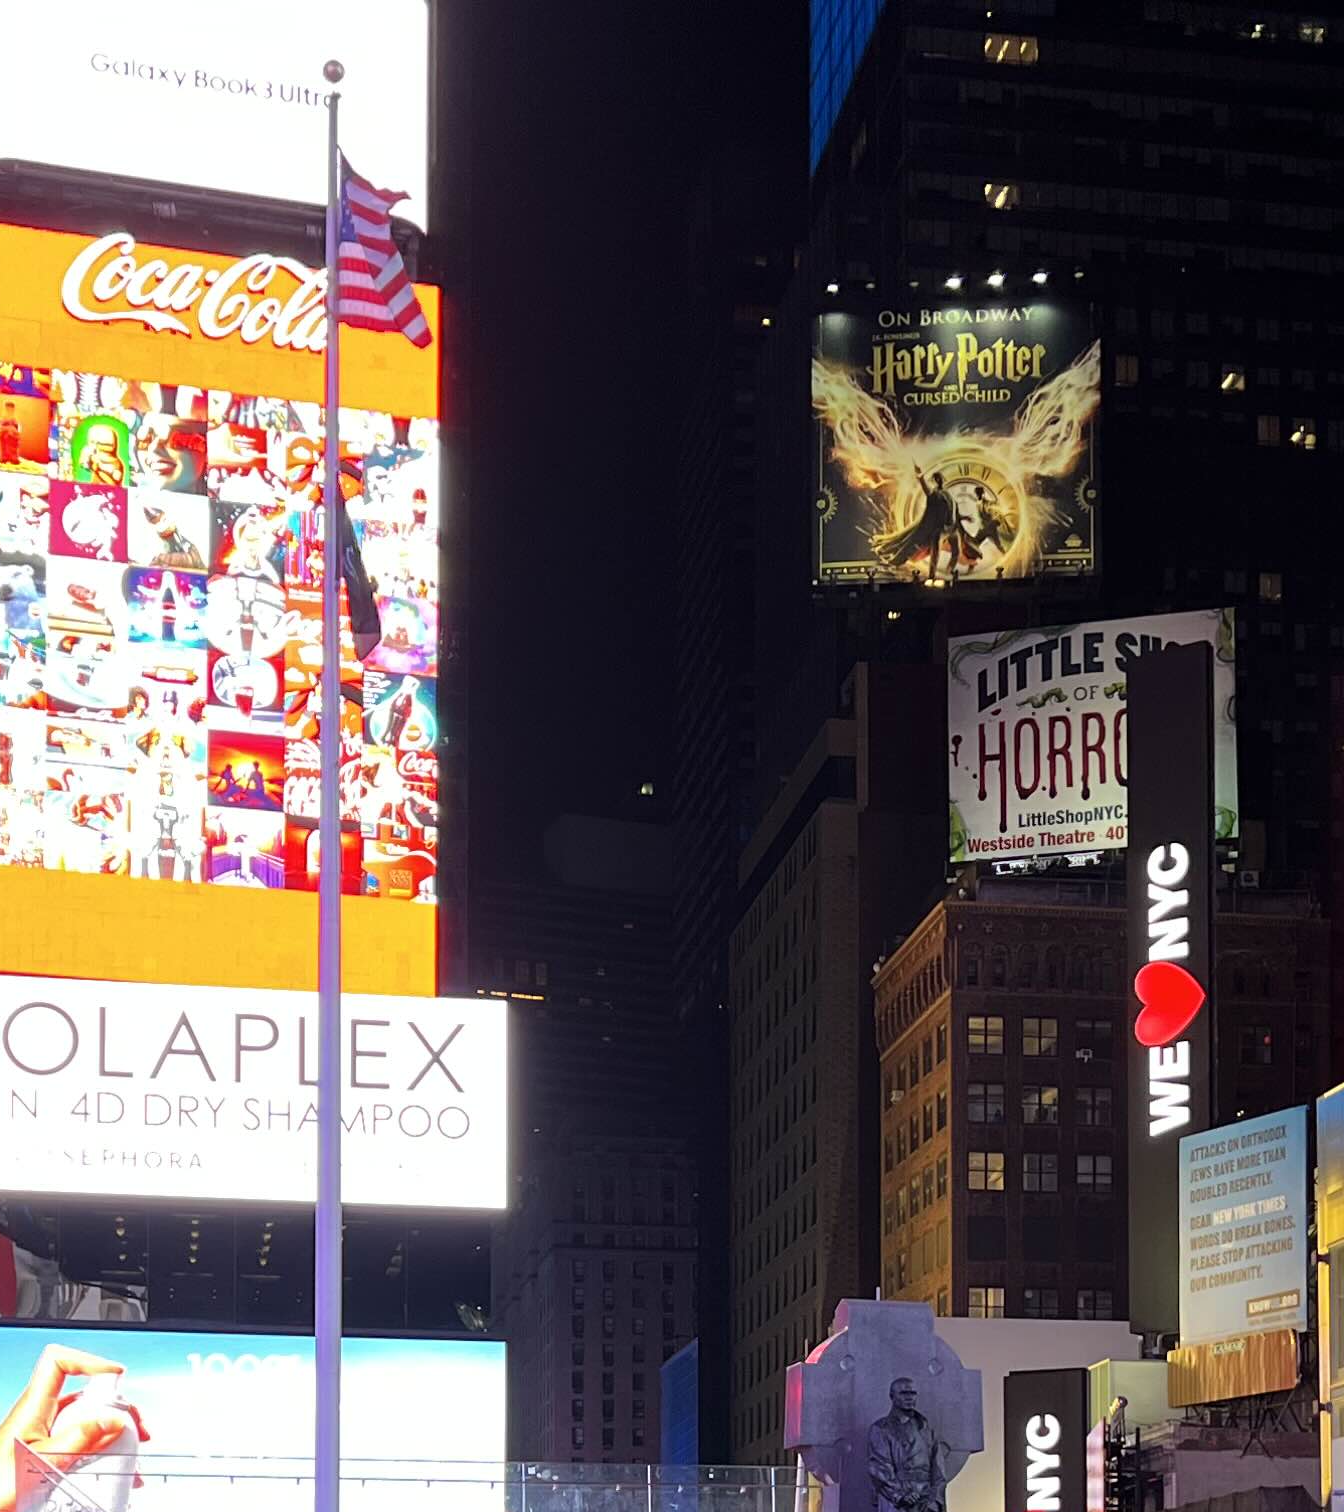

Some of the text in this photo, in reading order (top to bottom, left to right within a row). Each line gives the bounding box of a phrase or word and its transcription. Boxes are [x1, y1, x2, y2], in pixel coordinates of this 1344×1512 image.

[90, 52, 186, 88] Galaxy
[194, 69, 258, 97] Book
[920, 307, 1034, 327] BROADWAY
[866, 332, 1047, 399] Harry Potter
[903, 389, 1011, 406] CURSED CHILD
[977, 632, 1105, 713] LITTLE
[1073, 685, 1099, 701] OF
[967, 831, 1035, 854] Westside
[1038, 827, 1096, 848] Theatre
[1147, 841, 1190, 961] NYC
[1, 1001, 466, 1094] OLAPLEX
[1149, 1041, 1190, 1137] WE
[144, 1093, 227, 1130] DRY
[242, 1097, 471, 1140] SHAMPOO
[1190, 1140, 1226, 1163] ATTACKS
[1227, 1138, 1240, 1153] ON
[1190, 1146, 1287, 1184] JEWS HAVE MORE THAN
[1190, 1182, 1228, 1204] DOUBLED
[1190, 1236, 1293, 1273] PLEASE STOP ATTACKING
[1025, 1412, 1062, 1511] NYC
